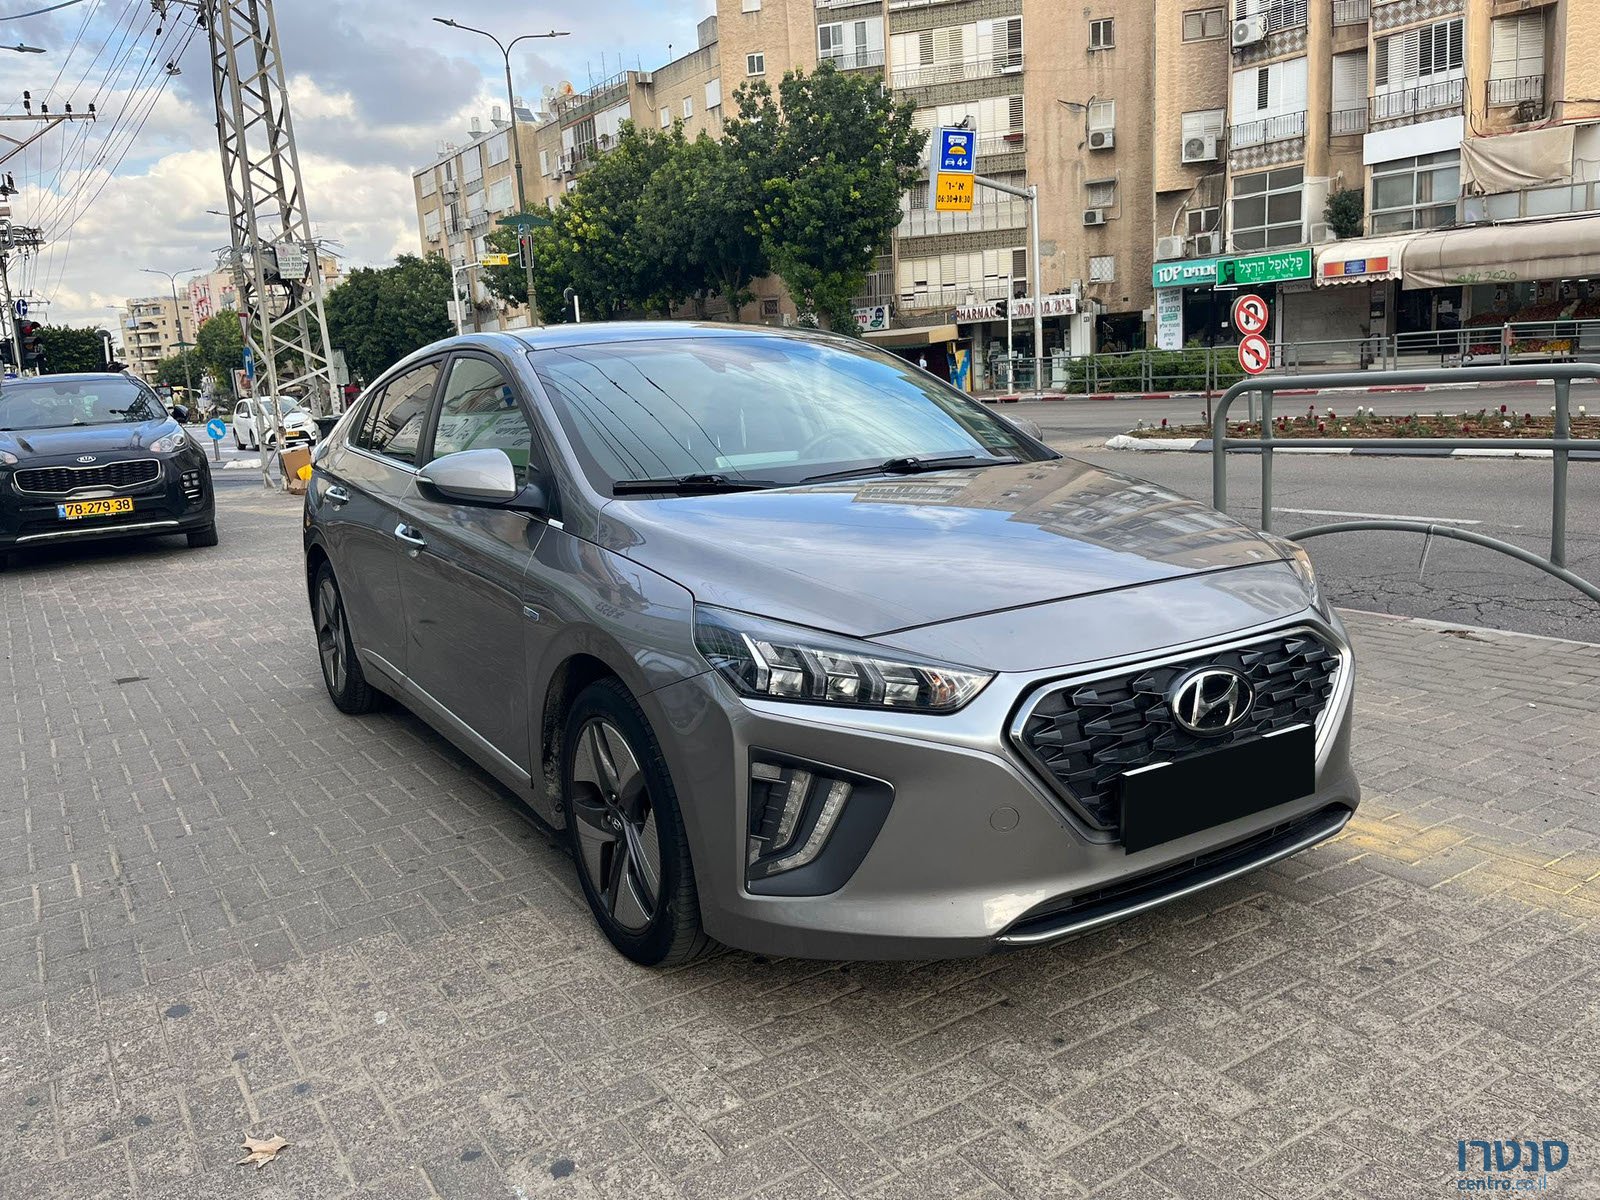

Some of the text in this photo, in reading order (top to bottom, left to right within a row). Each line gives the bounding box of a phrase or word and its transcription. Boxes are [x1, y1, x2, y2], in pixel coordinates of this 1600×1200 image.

[956, 157, 968, 167] 4+
[1156, 265, 1182, 283] TOP
[956, 305, 997, 320] PHARMAC
[78, 455, 96, 463] KIA
